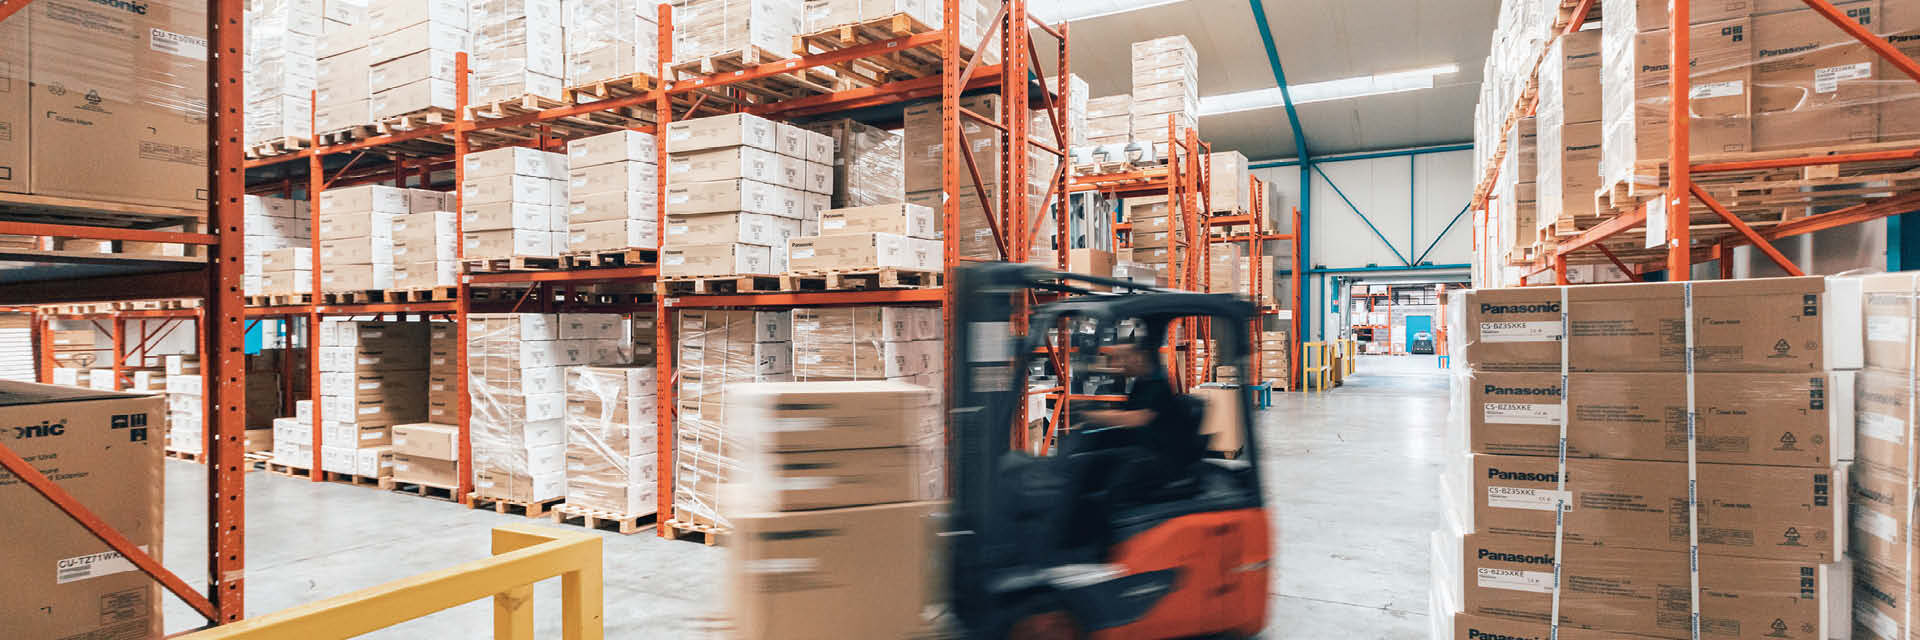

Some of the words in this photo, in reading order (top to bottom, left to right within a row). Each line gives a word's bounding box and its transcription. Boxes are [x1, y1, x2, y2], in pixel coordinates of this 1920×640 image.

[1888, 34, 1920, 43] Pana
[1480, 301, 1561, 314] Panasonic
[1489, 487, 1536, 496] CS-BZ35XKE
